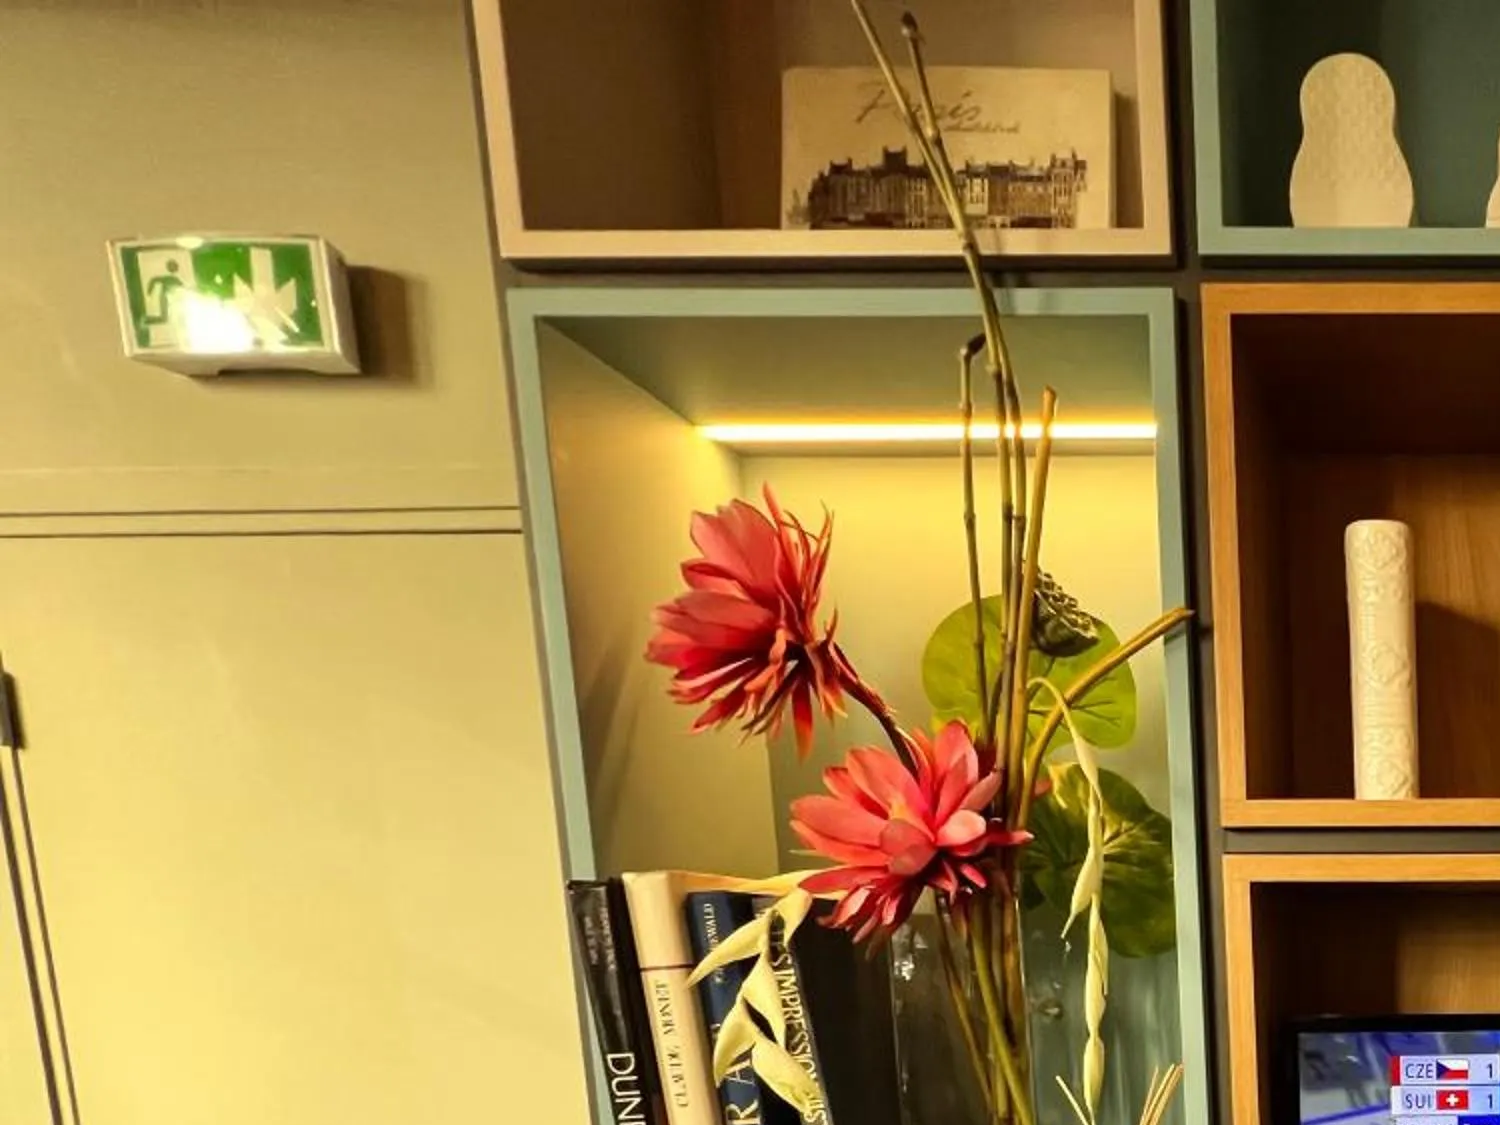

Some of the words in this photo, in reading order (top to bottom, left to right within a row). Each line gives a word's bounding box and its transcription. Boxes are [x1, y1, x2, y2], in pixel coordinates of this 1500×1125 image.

[655, 979, 677, 1035] MONET
[663, 1044, 690, 1108] CLAUDE
[1405, 1063, 1434, 1079] CZE
[1486, 1063, 1493, 1079] 1
[1404, 1093, 1432, 1109] SUI
[1487, 1093, 1494, 1109] 1
